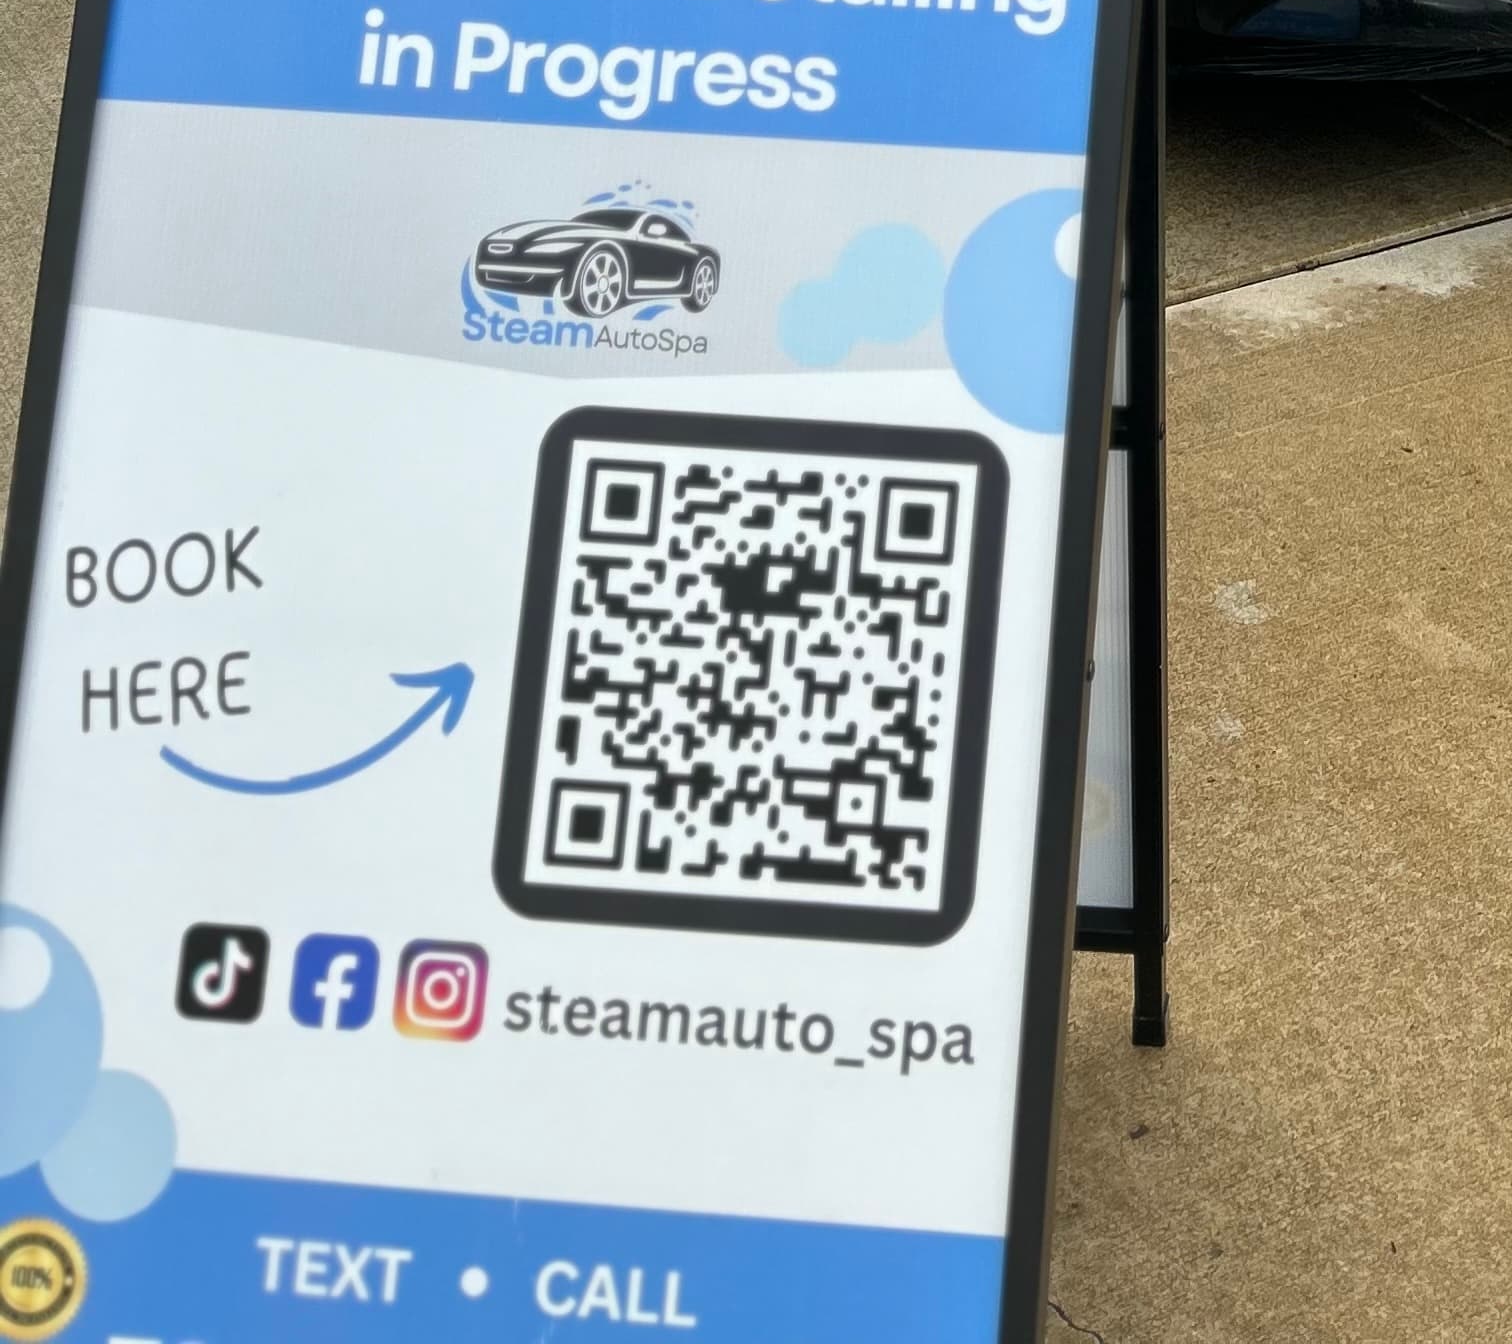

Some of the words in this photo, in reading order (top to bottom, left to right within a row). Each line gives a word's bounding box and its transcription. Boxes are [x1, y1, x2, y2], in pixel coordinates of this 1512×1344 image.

[359, 7, 435, 89] in
[453, 21, 838, 122] Progress
[66, 525, 264, 609] BOOK
[82, 650, 251, 734] HERE
[503, 985, 977, 1076] steamauto_spa
[10, 1265, 54, 1291] 100%
[256, 1236, 414, 1305] TEXT
[534, 1258, 698, 1329] CALL
